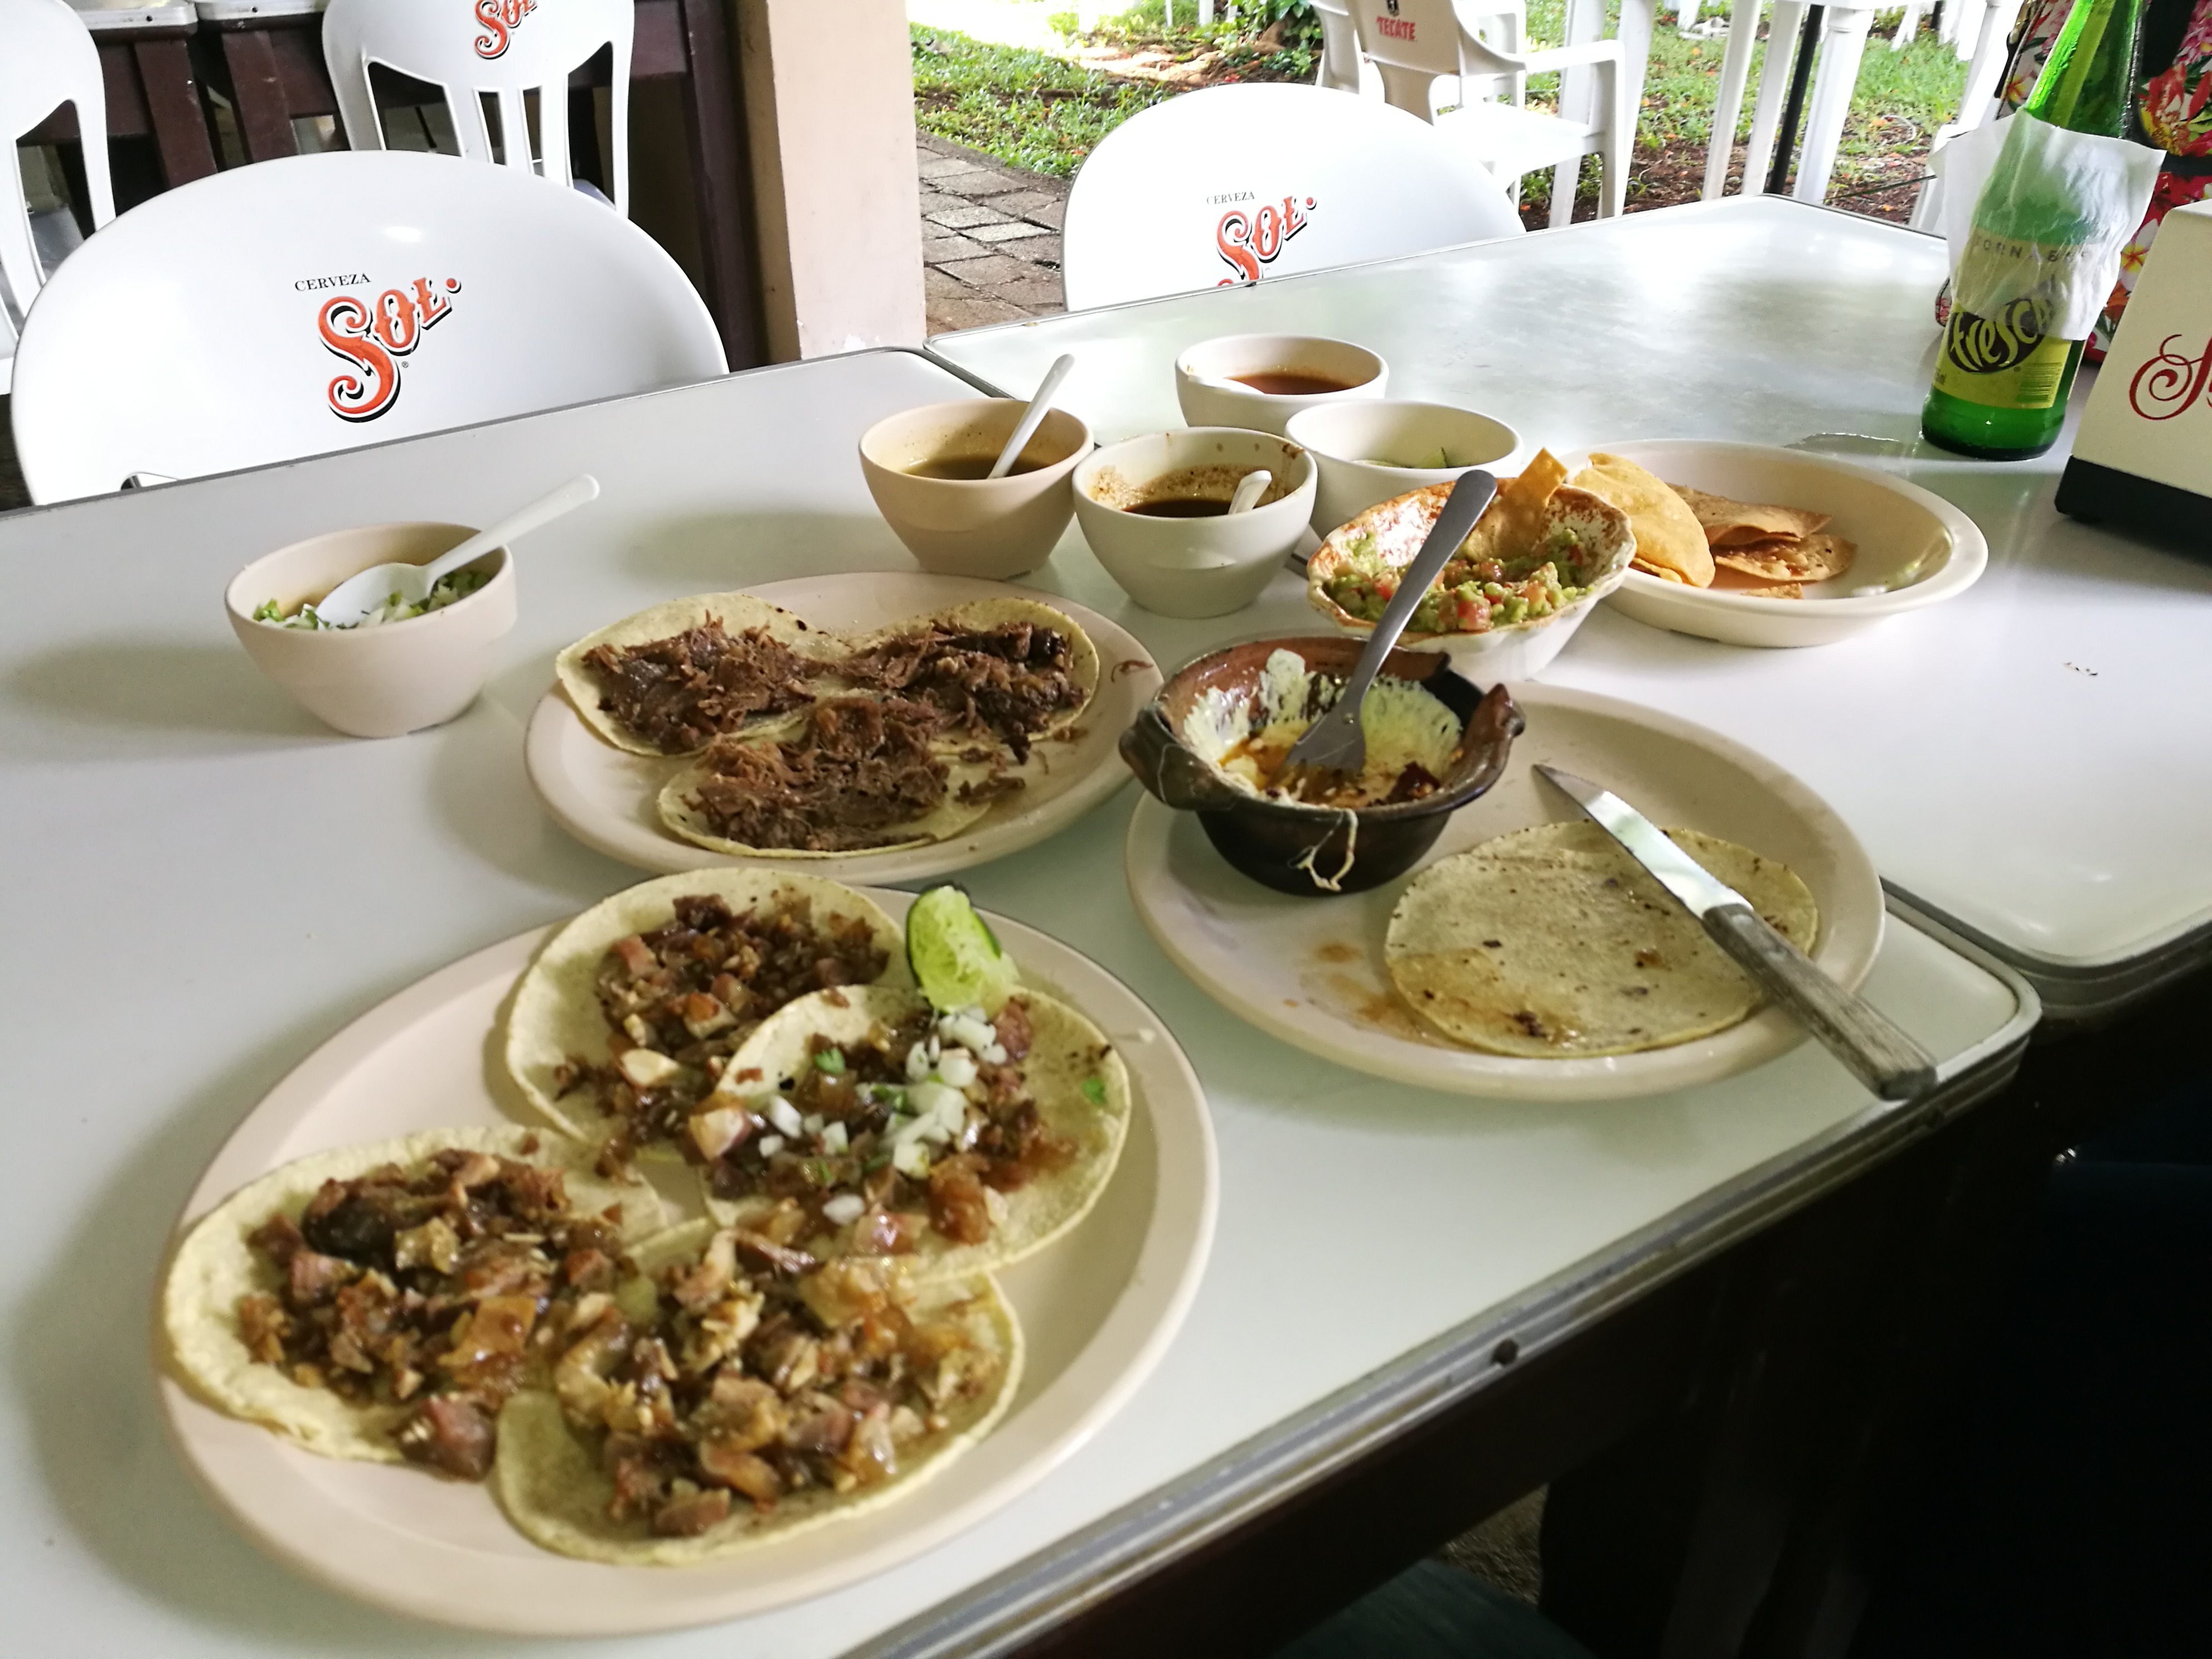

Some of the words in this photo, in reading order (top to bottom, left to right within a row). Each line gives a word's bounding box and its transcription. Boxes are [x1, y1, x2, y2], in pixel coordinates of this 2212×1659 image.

[1376, 16, 1417, 41] TECATE
[1206, 191, 1255, 205] CERVEZA
[294, 273, 372, 292] CERVEZA
